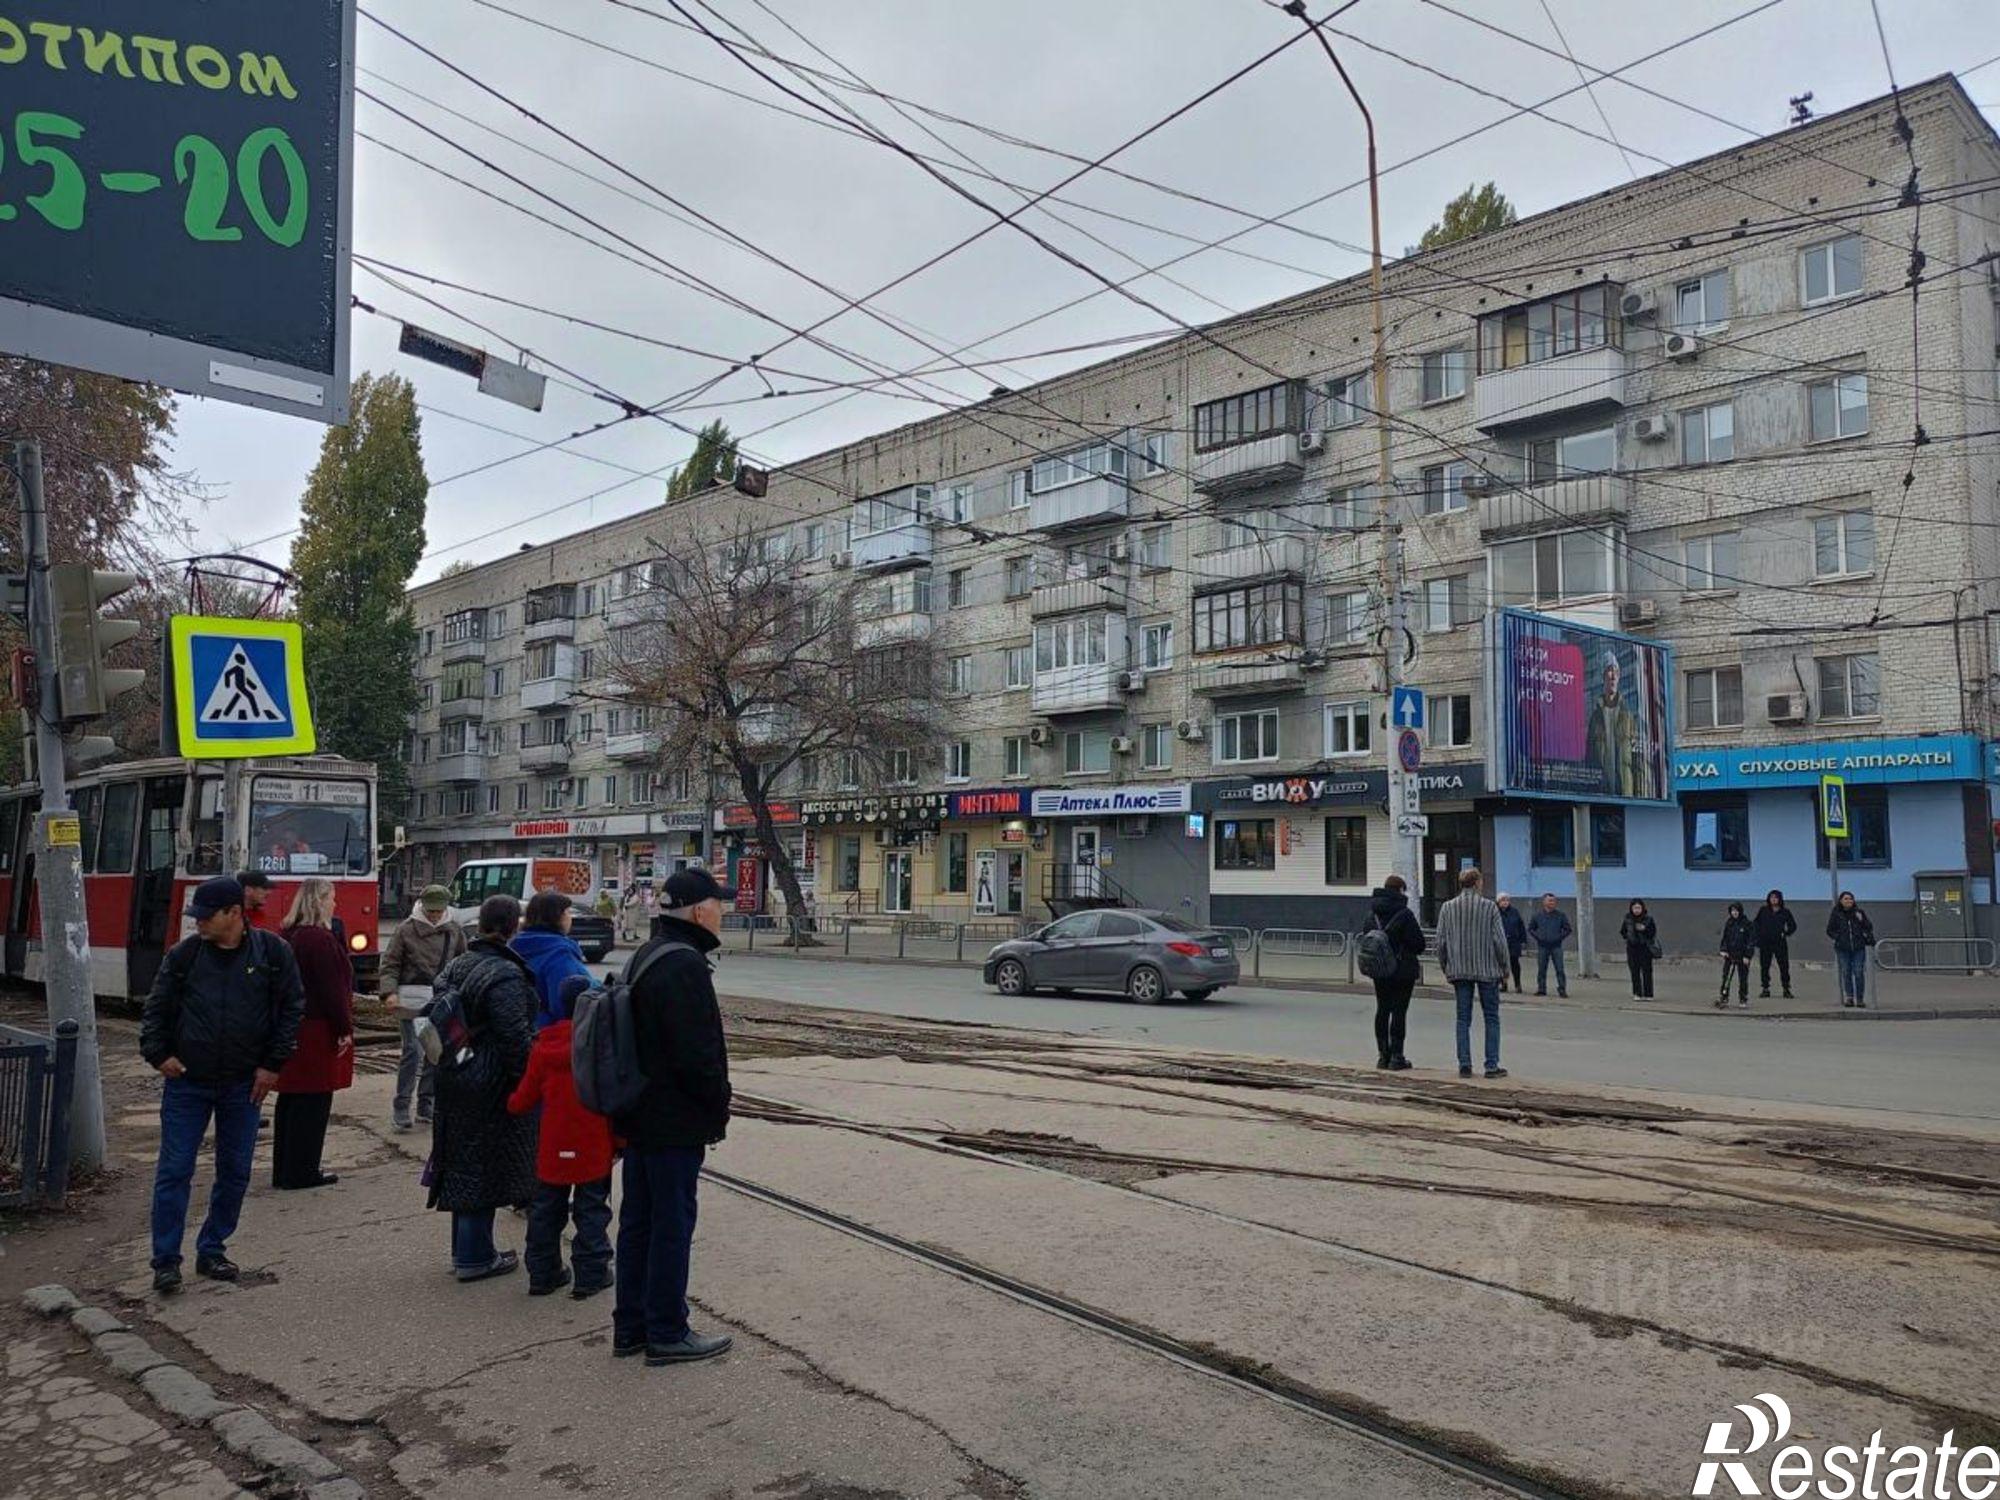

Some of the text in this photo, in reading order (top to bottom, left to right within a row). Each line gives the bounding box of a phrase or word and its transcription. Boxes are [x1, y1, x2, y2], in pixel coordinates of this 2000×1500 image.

[0, 111, 309, 247] 5-20
[1738, 751, 1952, 774] СЛУХОВЫЕ АППАРАТЫ
[303, 784, 320, 800] 11
[1252, 777, 1326, 803] ВИЖУ
[1417, 775, 1464, 789] ПТИКА
[959, 793, 1019, 814] ИНТИМ
[259, 856, 287, 871] 1260
